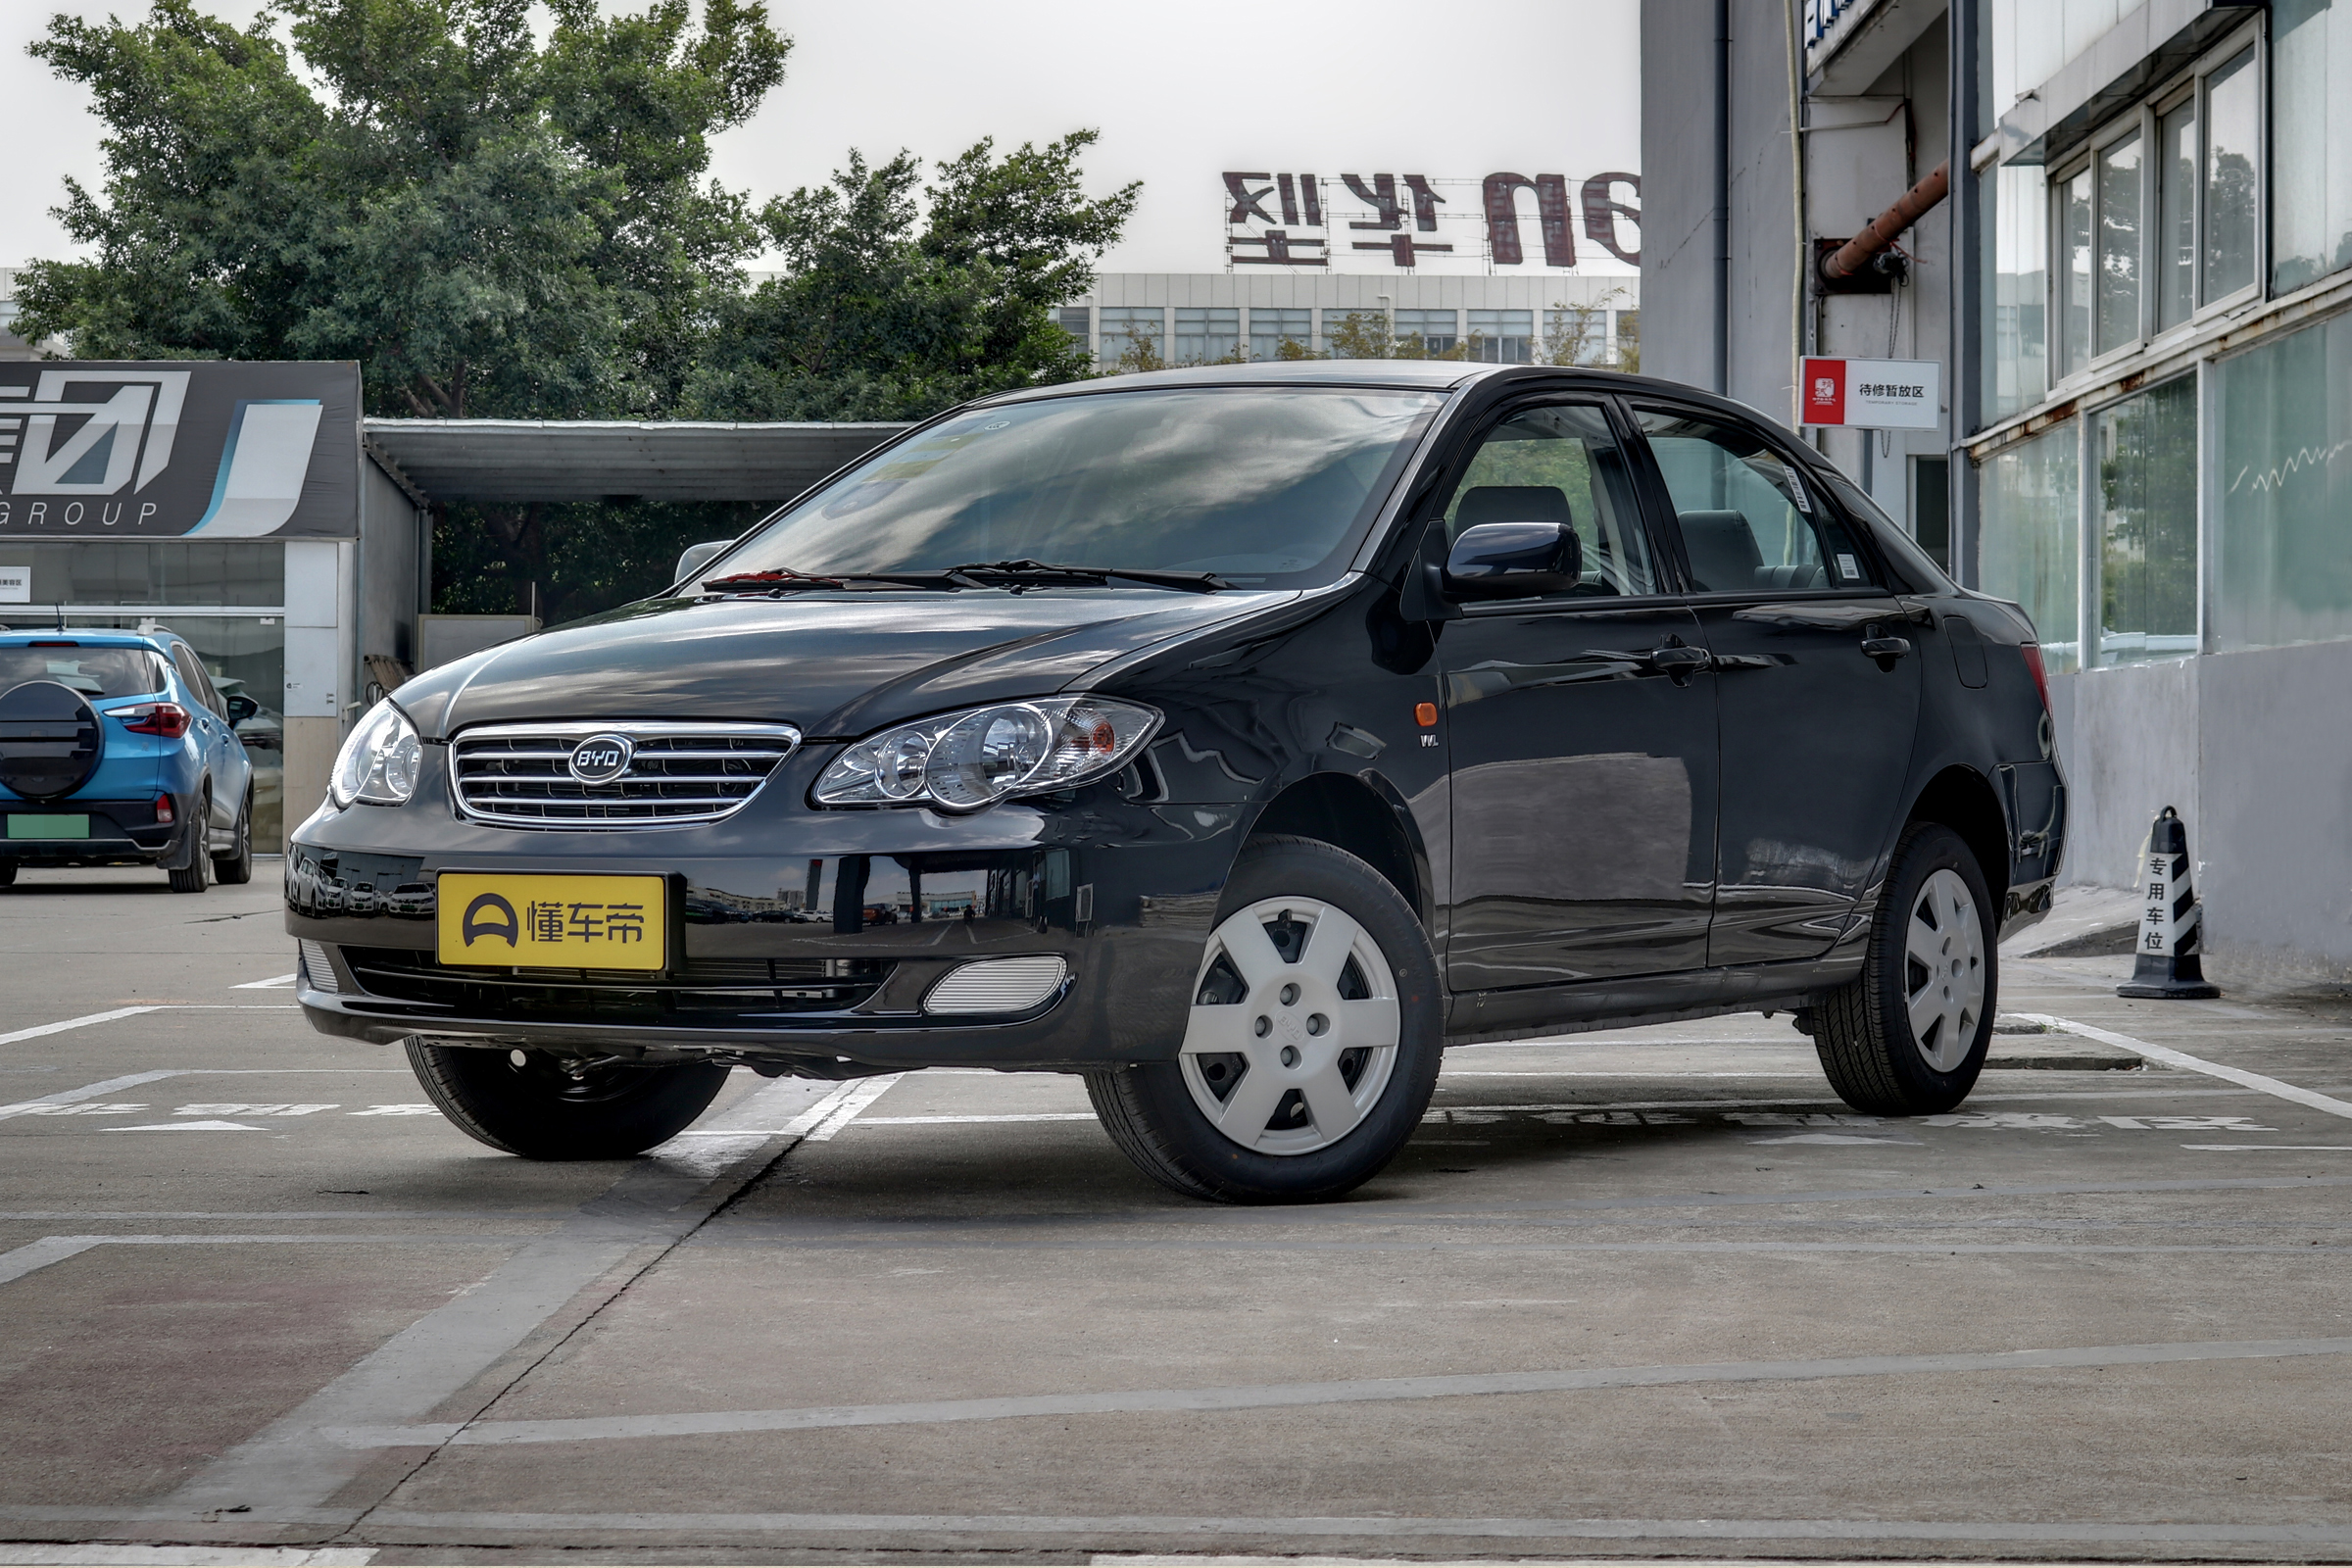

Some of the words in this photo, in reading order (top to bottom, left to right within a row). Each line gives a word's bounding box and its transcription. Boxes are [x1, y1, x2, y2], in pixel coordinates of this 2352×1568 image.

[1859, 383, 1925, 398] 待修暂放区
[576, 750, 619, 766] BYD
[2144, 857, 2167, 950] 专用车位
[526, 900, 645, 944] 懂车帝
[1277, 1015, 1301, 1041] BYD
